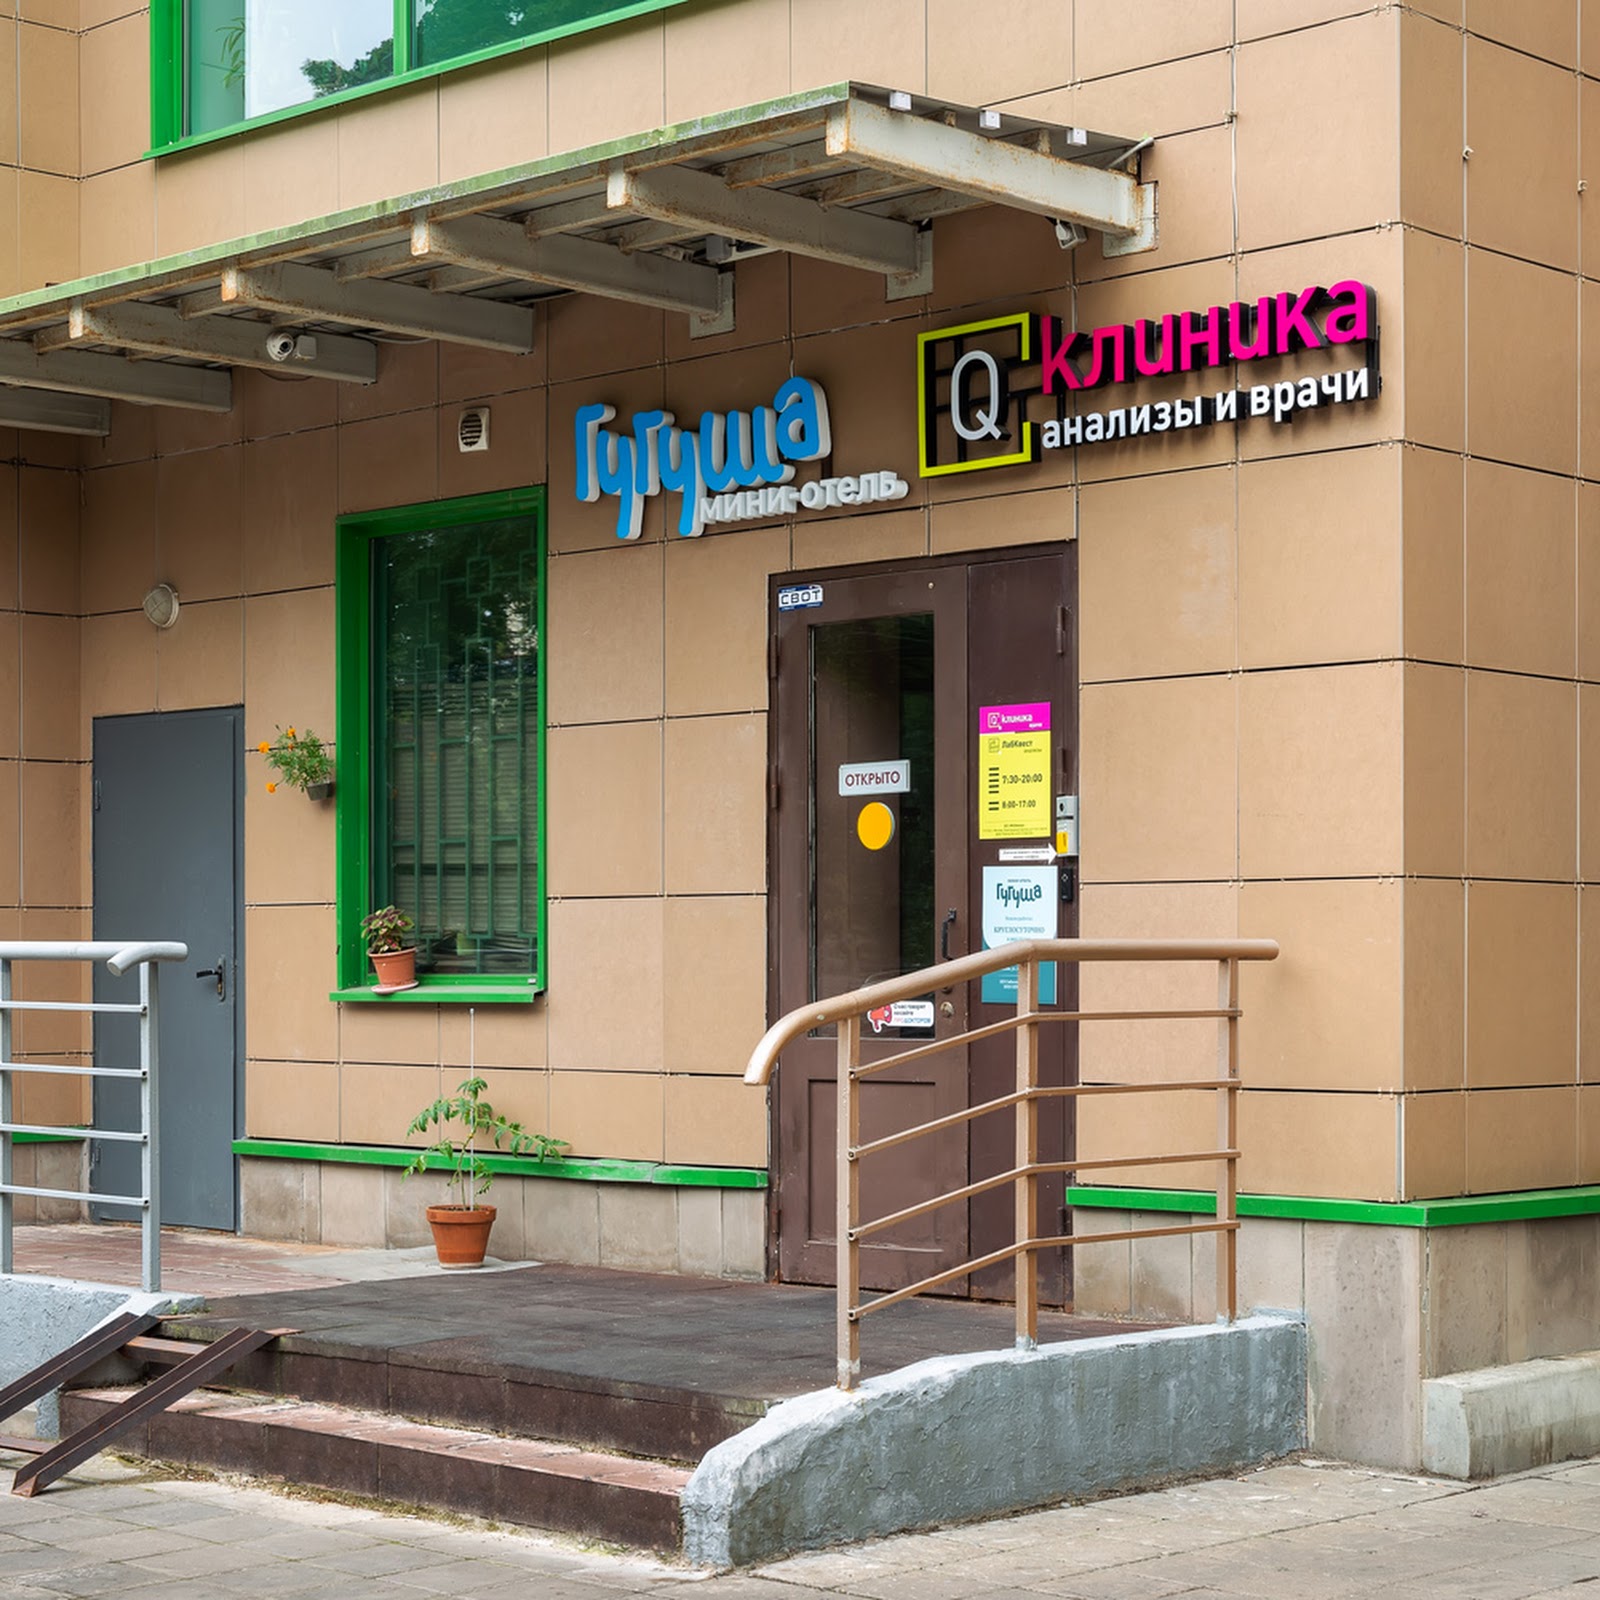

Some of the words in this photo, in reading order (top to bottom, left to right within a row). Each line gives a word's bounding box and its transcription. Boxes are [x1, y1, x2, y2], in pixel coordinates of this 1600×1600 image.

[1041, 279, 1370, 394] клиника
[950, 349, 1001, 441] Q
[1041, 397, 1202, 449] анализы
[1215, 392, 1237, 422] и
[1249, 367, 1369, 422] врачи
[574, 376, 831, 540] Гугуша
[699, 470, 909, 525] мини-отель
[780, 589, 821, 605] СВОТ
[844, 770, 901, 787] ОТКРЫТО
[1002, 773, 1043, 785] 7:30-20:00
[996, 882, 1042, 909] Гугуша
